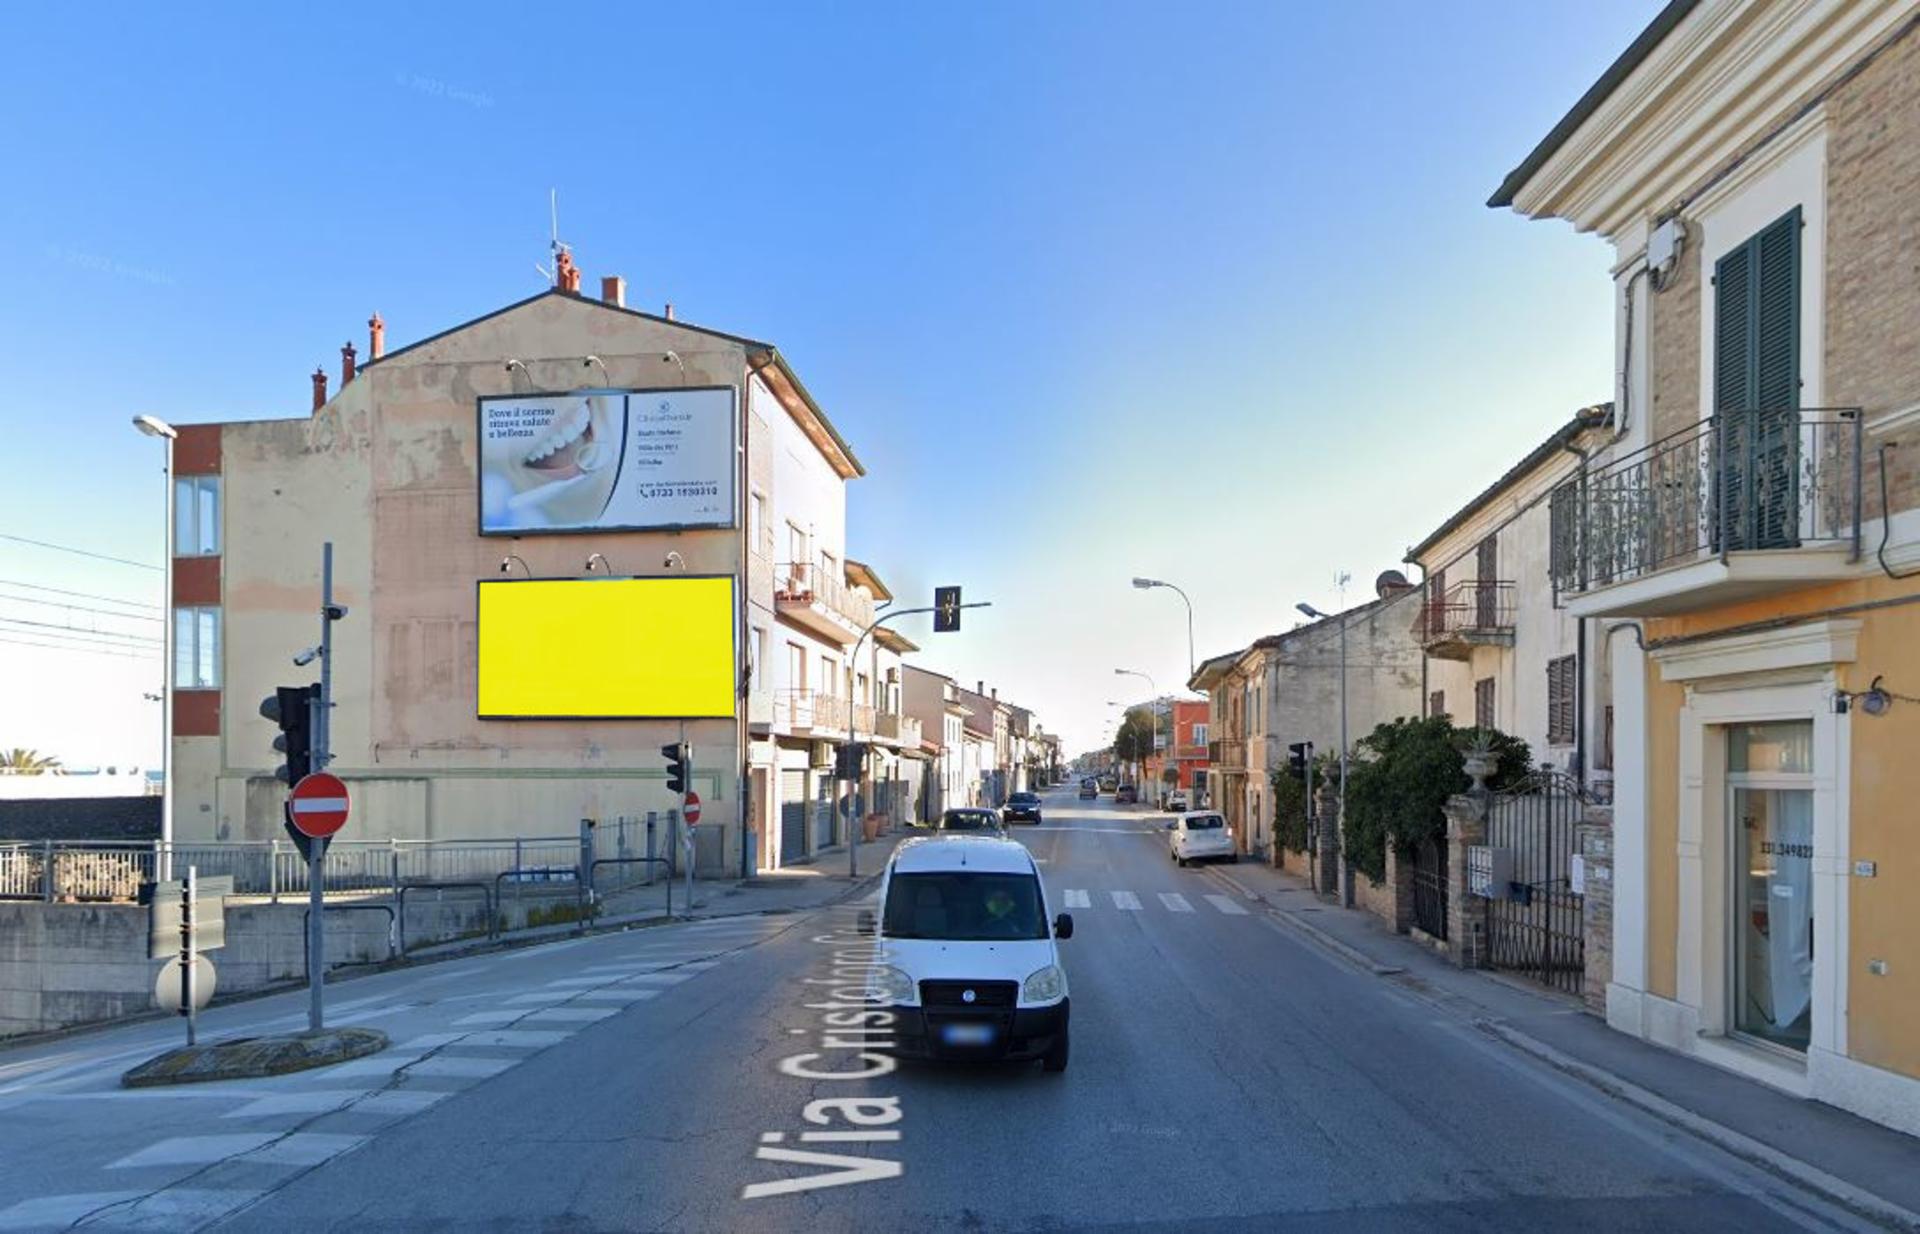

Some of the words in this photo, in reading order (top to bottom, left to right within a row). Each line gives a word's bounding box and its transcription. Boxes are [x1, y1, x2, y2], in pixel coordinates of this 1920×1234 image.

[488, 408, 511, 418] Dove
[522, 417, 551, 426] salute
[496, 428, 535, 438] bellezza
